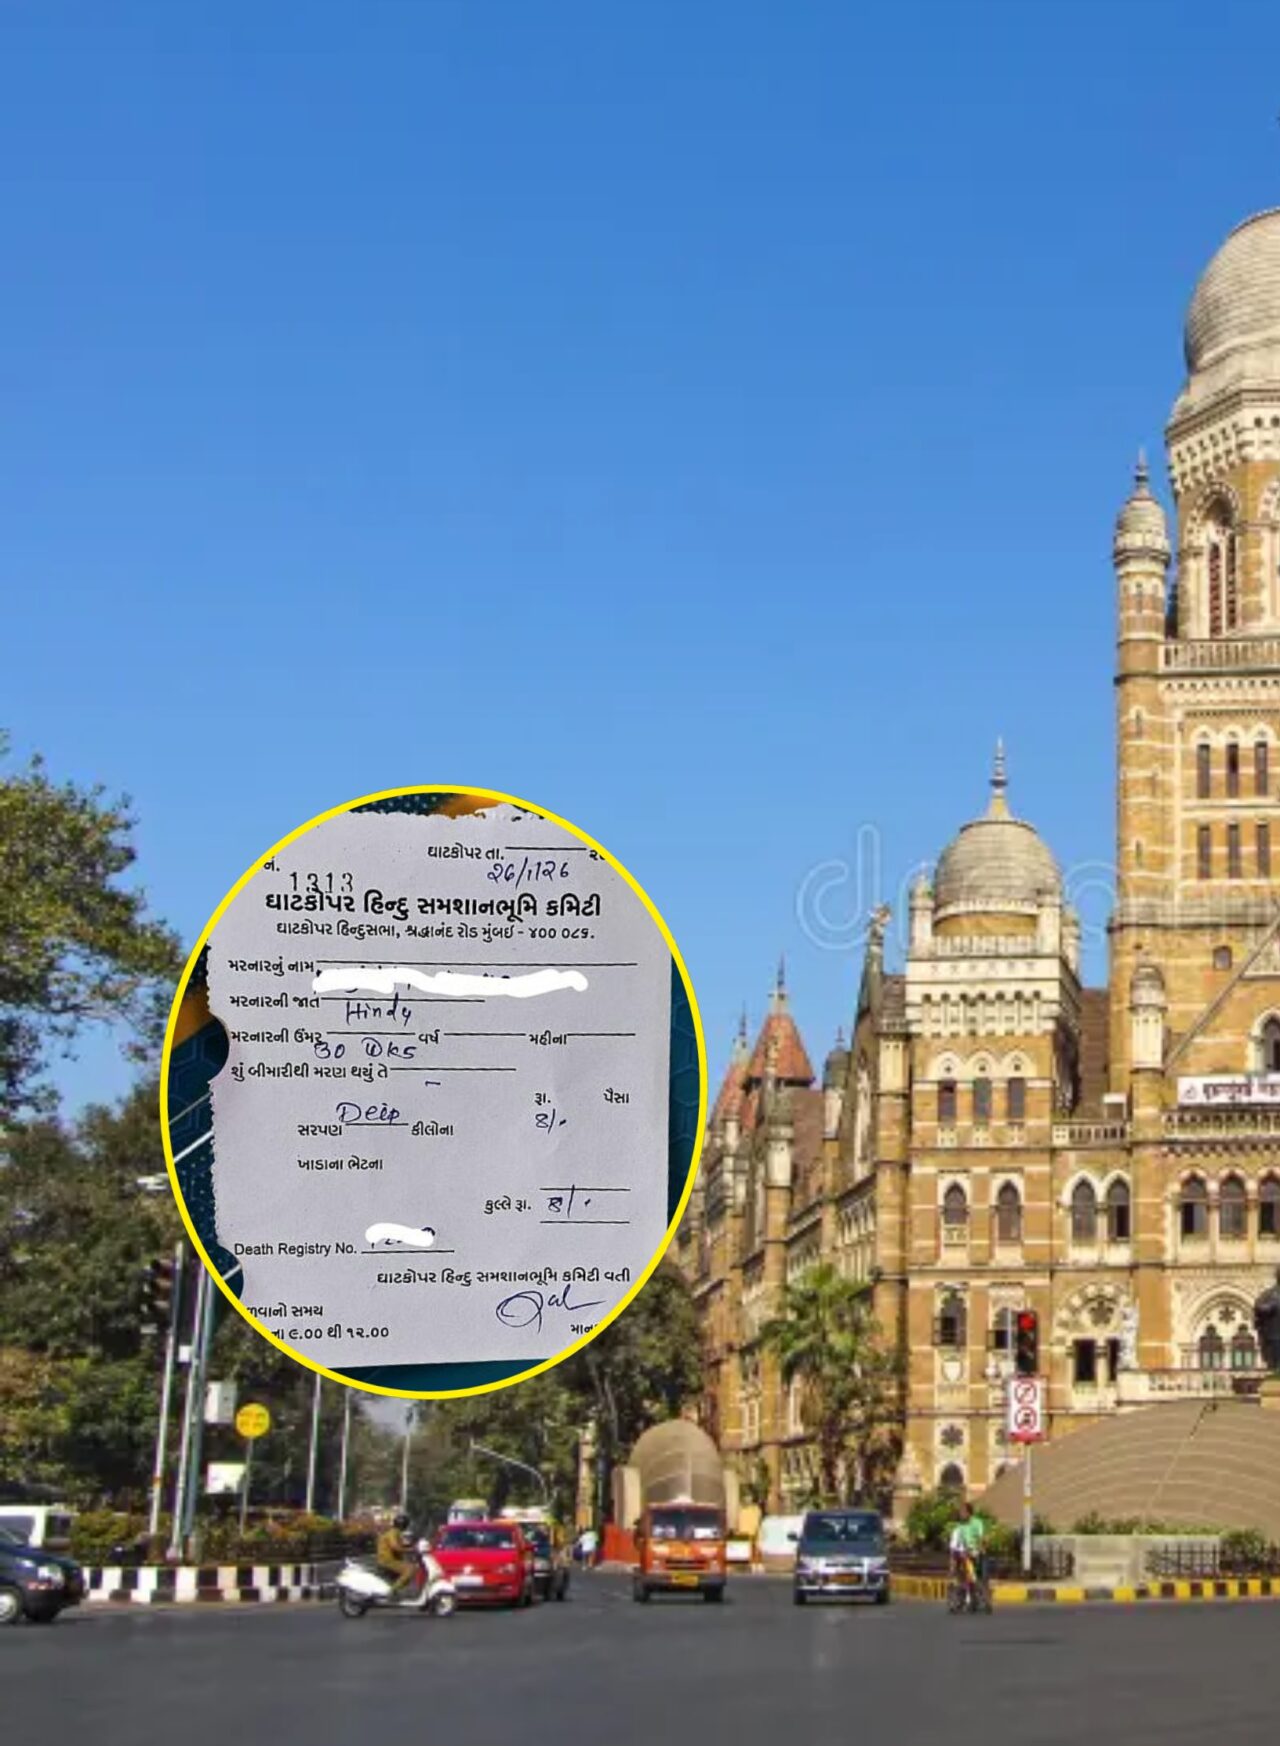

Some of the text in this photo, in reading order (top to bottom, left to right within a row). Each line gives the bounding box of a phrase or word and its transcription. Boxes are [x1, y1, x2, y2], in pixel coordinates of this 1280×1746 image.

[427, 842, 481, 860] ઘાટકોપર
[265, 889, 356, 913] ઘાટકોપર
[363, 888, 410, 921] હિન્દુ
[545, 893, 601, 918] કમિટી
[277, 919, 333, 935] ઘાટકોપર
[456, 919, 478, 939] રોડ
[481, 922, 515, 944] મુંબઈ
[228, 956, 314, 976] મરનારનું નામ
[229, 994, 289, 1009] મરનારની
[230, 1030, 289, 1044] મરનારની
[418, 1029, 441, 1045] વર્ષ
[529, 1030, 567, 1046] મહીના
[231, 1062, 389, 1083] શું બીમારીથી મરણ થયું તે
[603, 1087, 630, 1104] પૈસા
[297, 1120, 455, 1137] સરપણ કીલોના
[233, 1241, 358, 1258] Death Registry No.
[377, 1268, 437, 1284] ઘાટકોપર
[440, 1267, 473, 1288] હિન્દુ
[562, 1266, 600, 1282] કમિટી
[604, 1266, 630, 1282] વતી
[290, 1304, 324, 1318] સમય
[326, 1323, 343, 1339] થી
